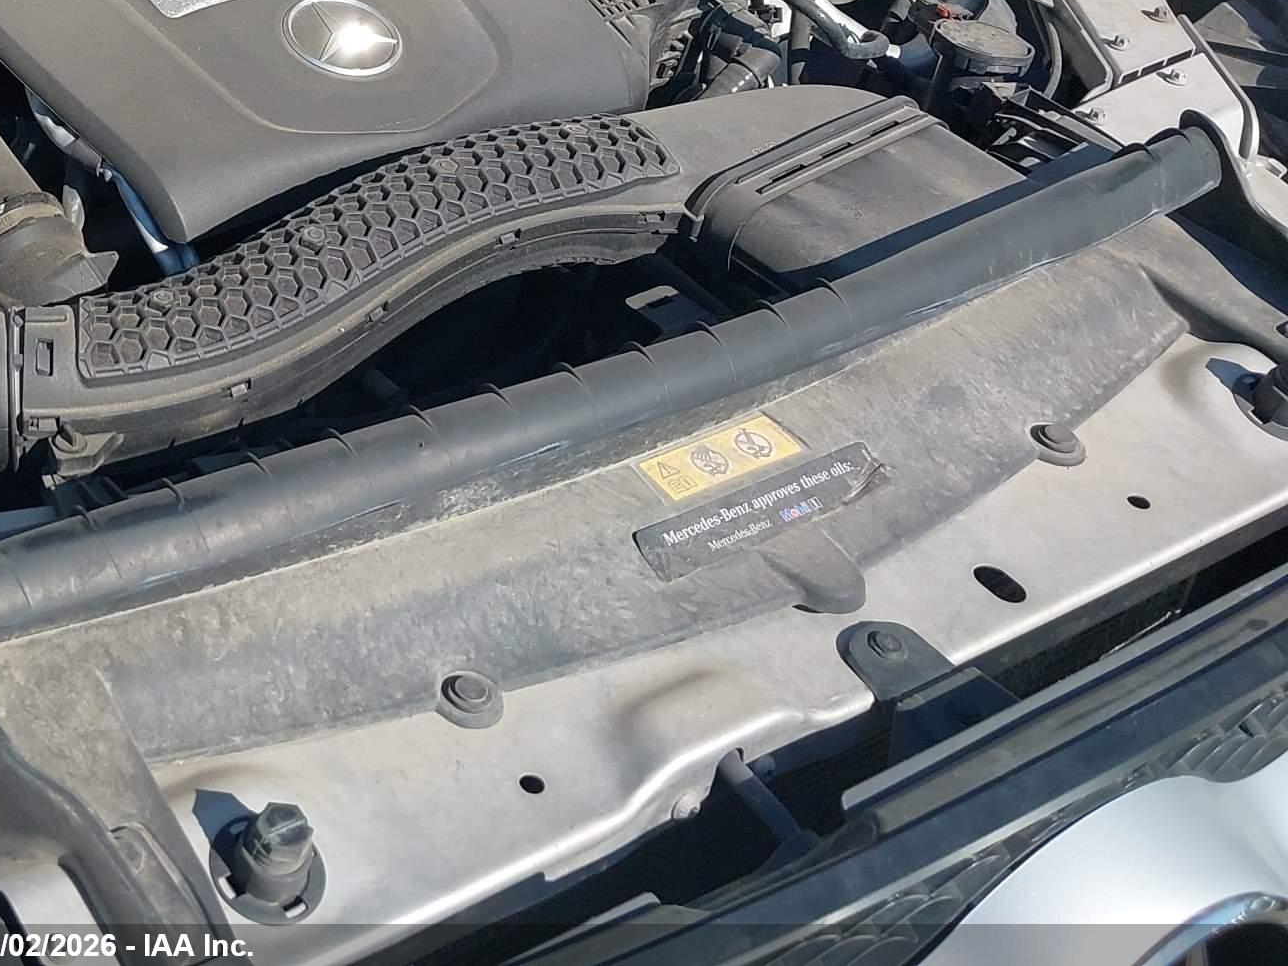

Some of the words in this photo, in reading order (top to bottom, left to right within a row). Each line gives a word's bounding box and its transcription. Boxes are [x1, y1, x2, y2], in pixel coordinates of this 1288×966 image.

[662, 503, 752, 546] Mercedes-Benz
[751, 481, 801, 510] approves
[800, 469, 831, 490] these
[830, 461, 855, 477] oils:
[707, 519, 773, 552] Mercedes-Benz
[778, 500, 813, 522] Mobil
